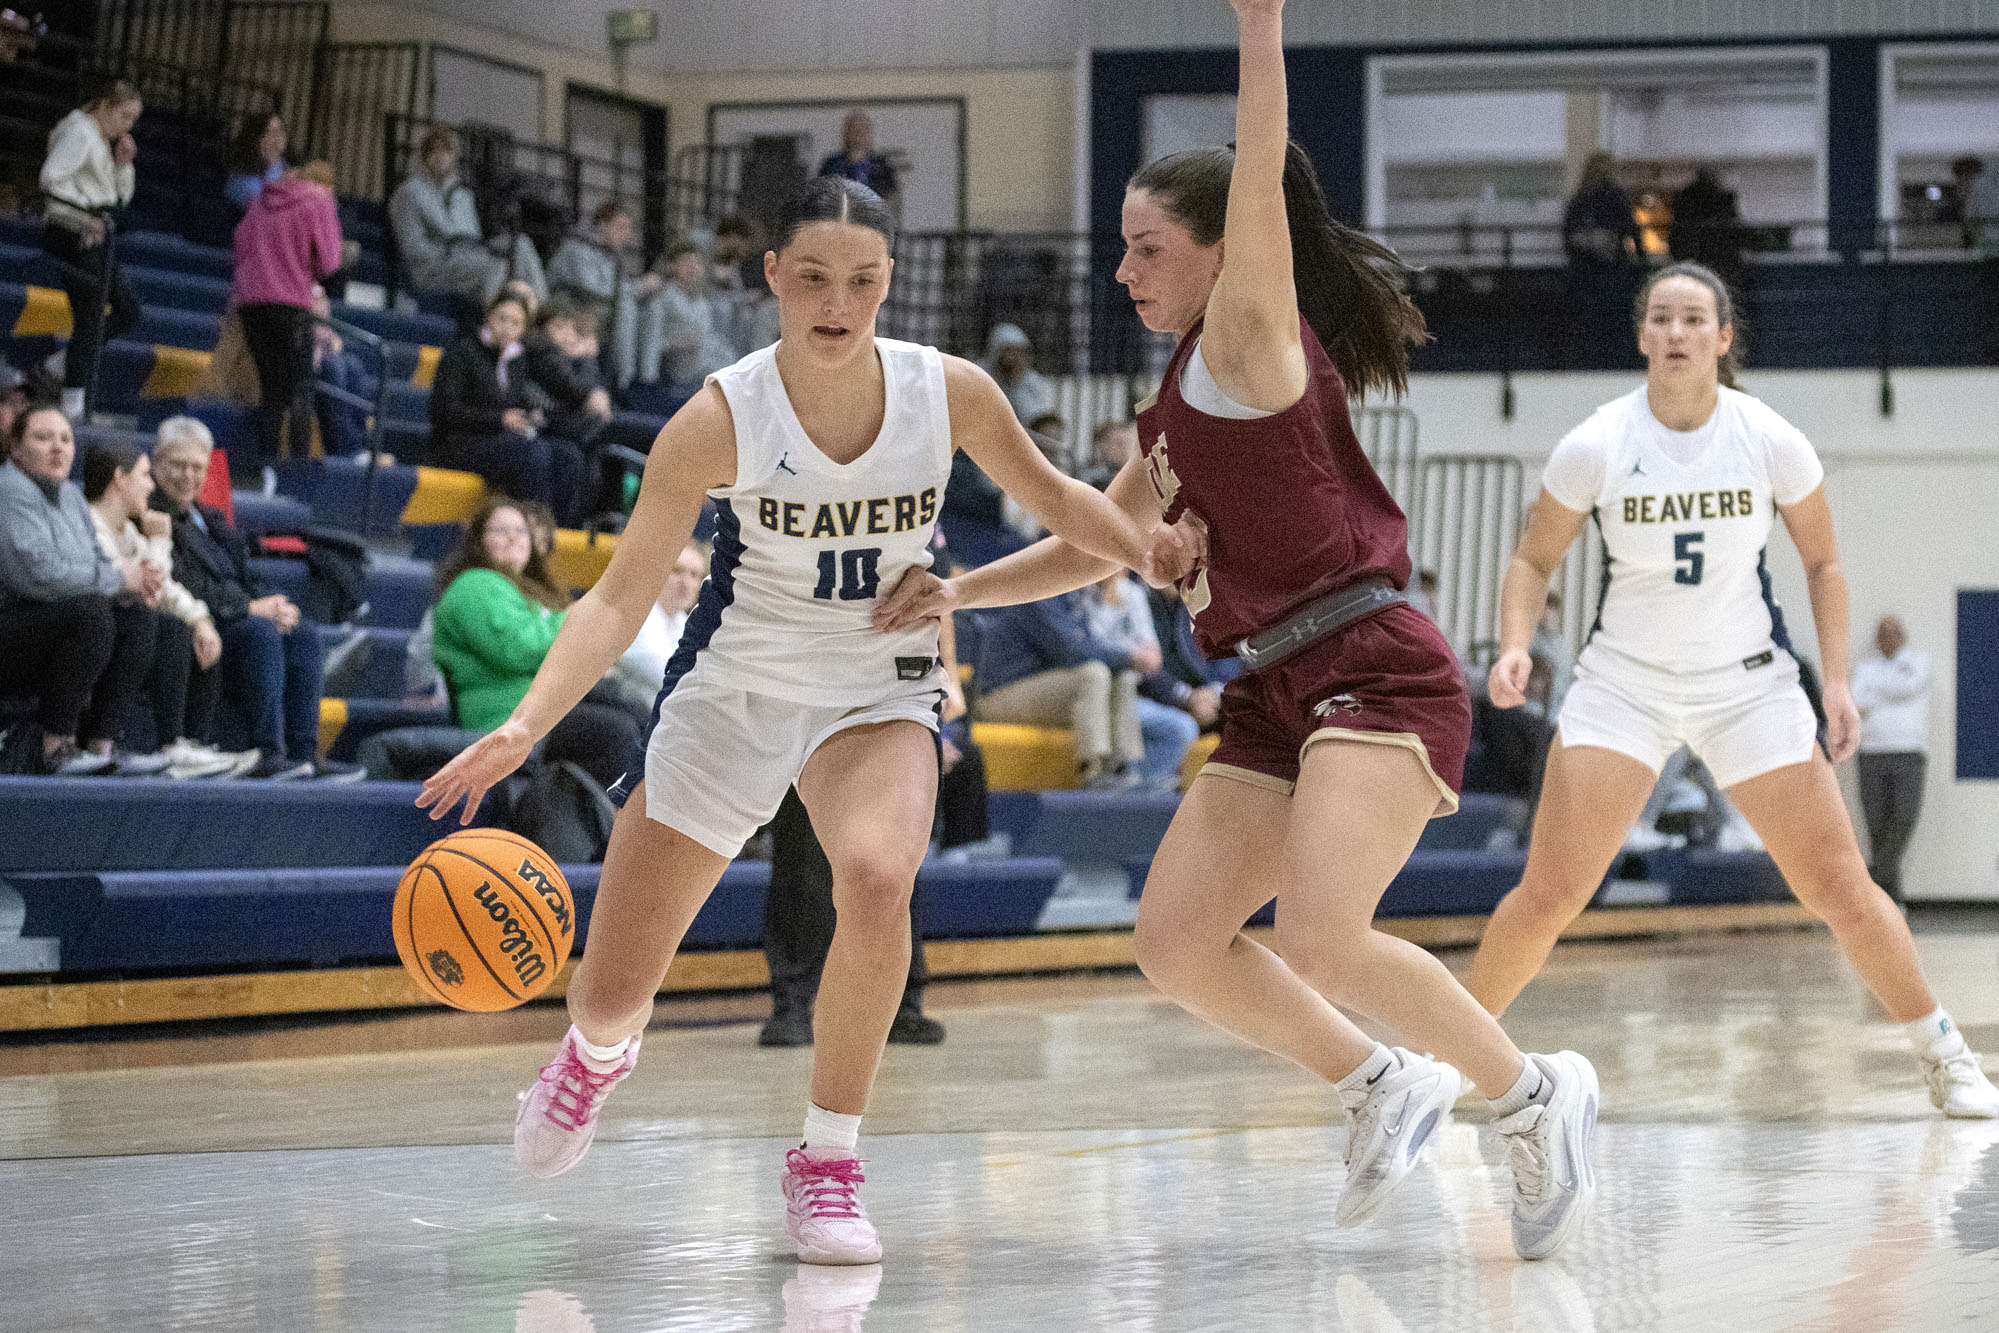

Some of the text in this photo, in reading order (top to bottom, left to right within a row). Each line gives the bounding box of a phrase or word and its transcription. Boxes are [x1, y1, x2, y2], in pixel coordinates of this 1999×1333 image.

[758, 487, 937, 539] BEAVERS
[1624, 489, 1753, 524] BEAVERS
[813, 547, 883, 601] 10
[1674, 532, 1705, 586] 5
[518, 859, 572, 937] NCAA
[473, 881, 546, 987] Wilson
